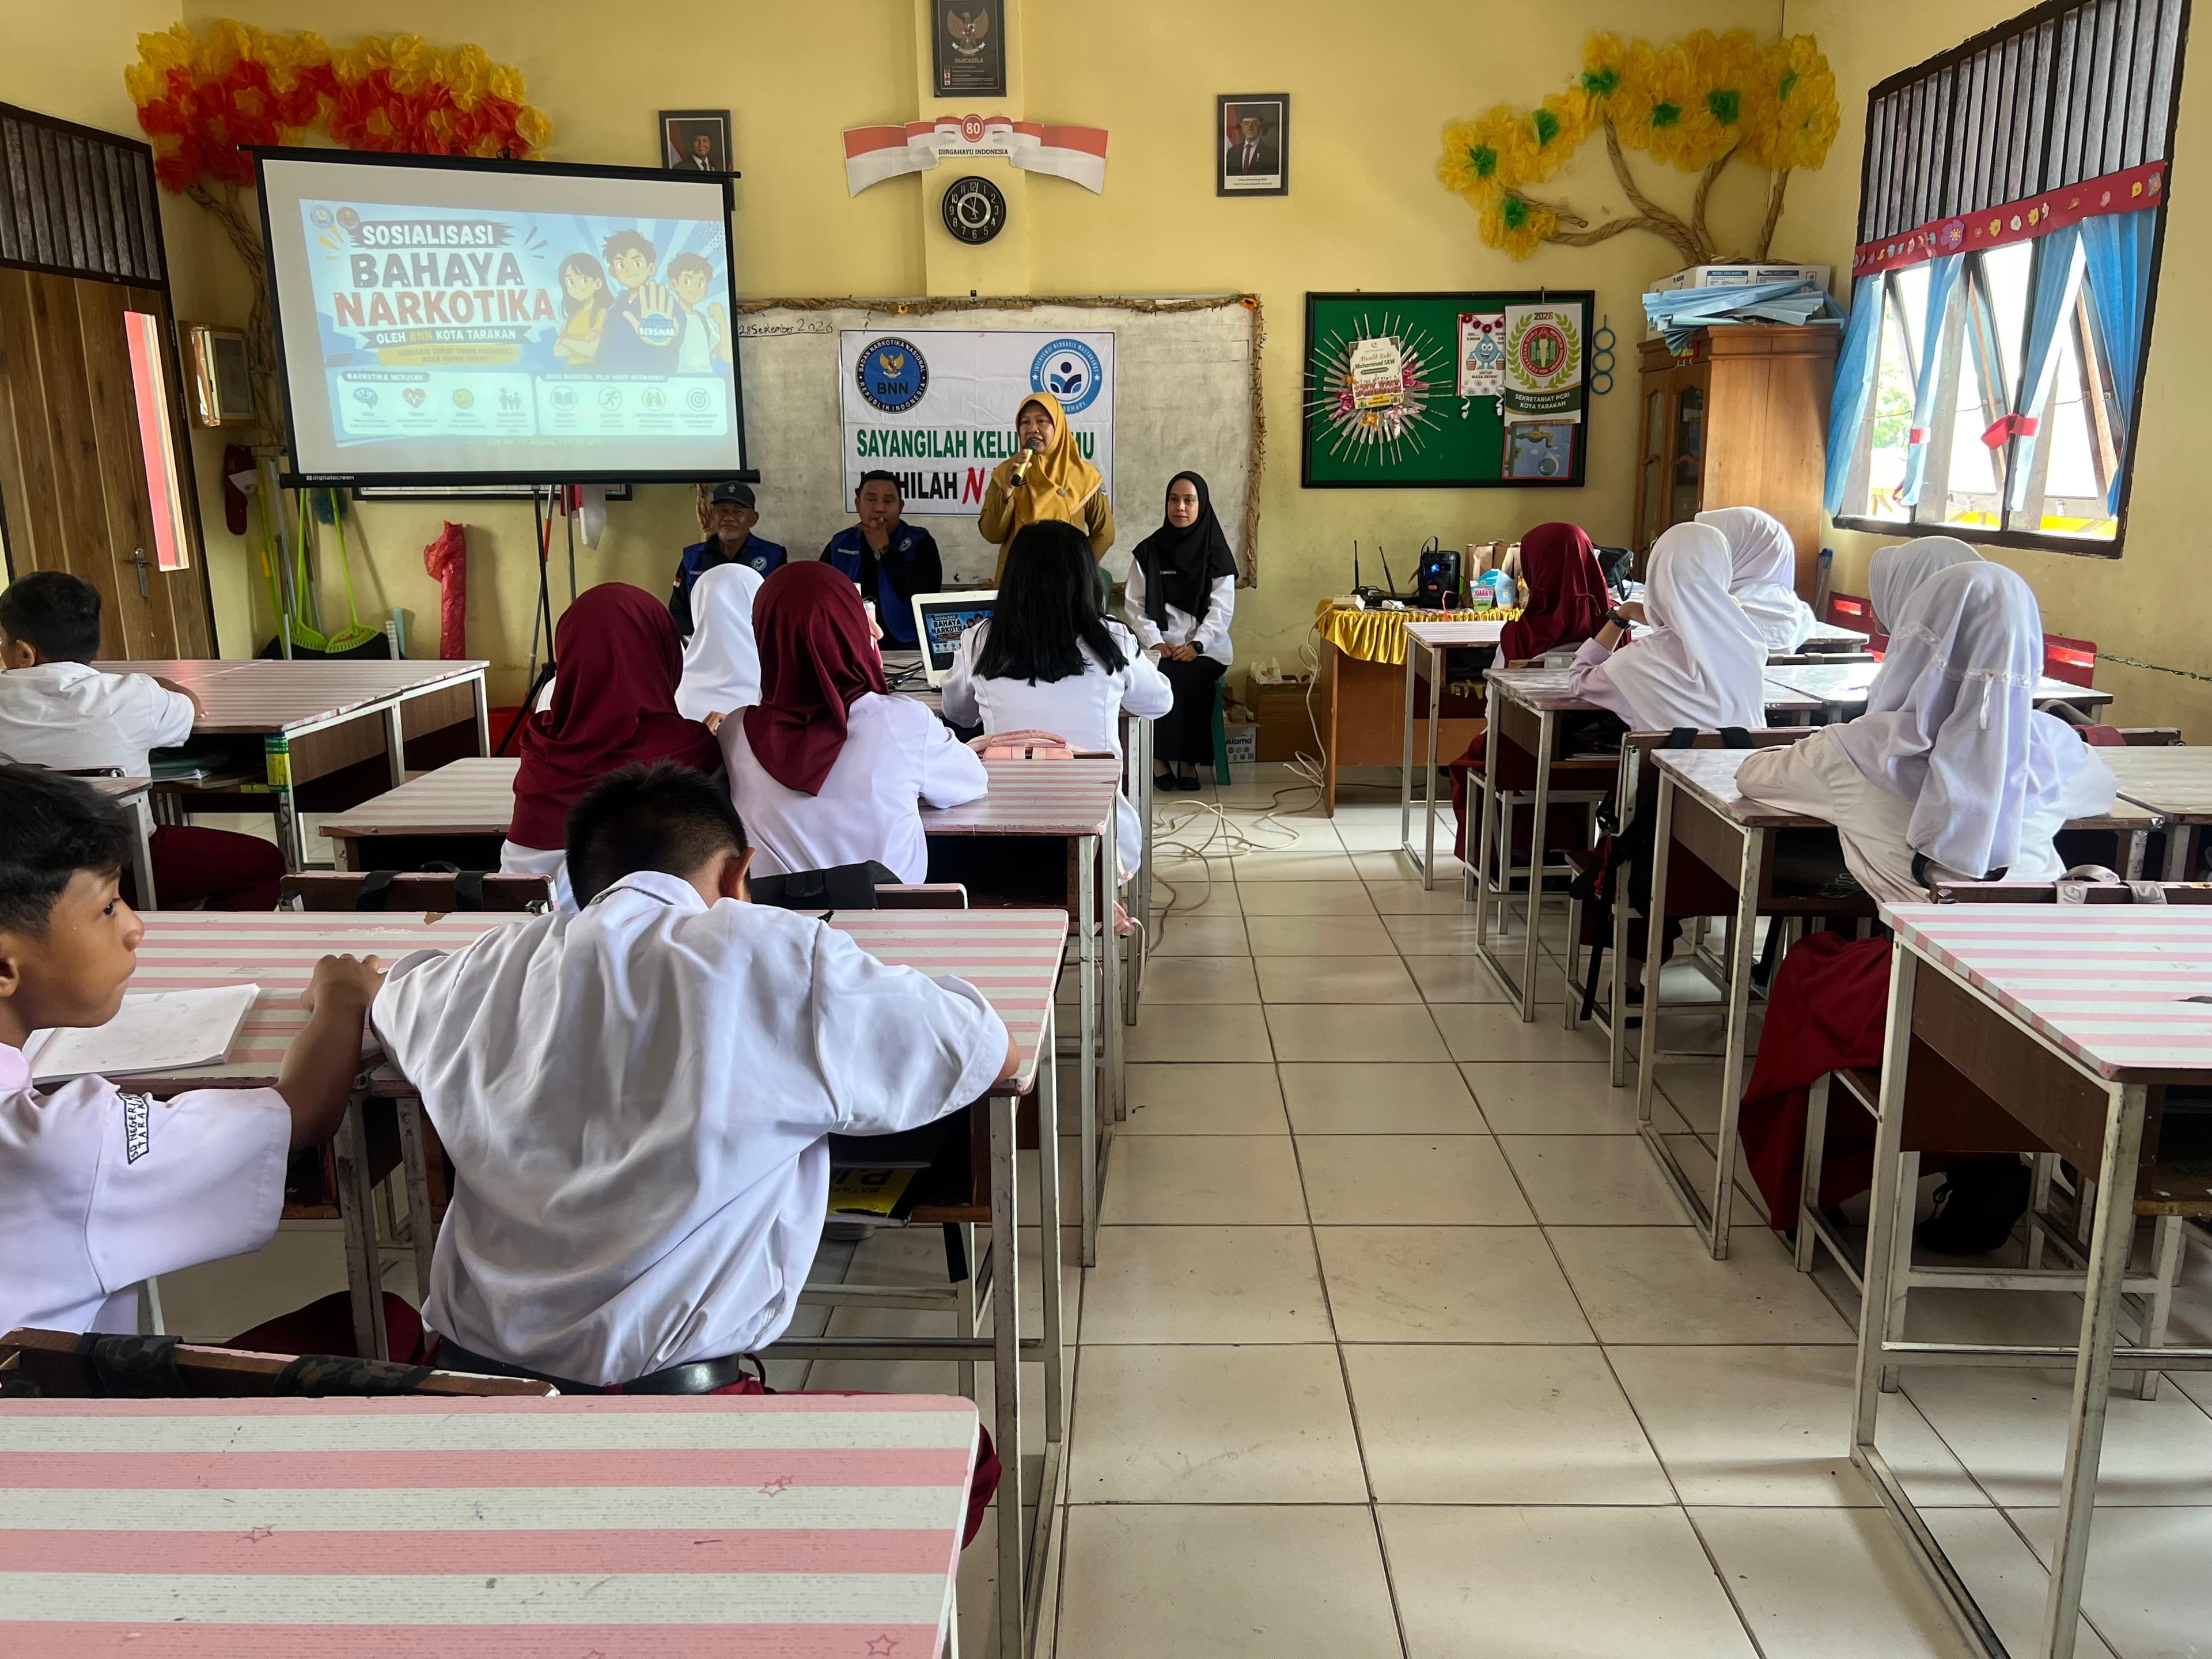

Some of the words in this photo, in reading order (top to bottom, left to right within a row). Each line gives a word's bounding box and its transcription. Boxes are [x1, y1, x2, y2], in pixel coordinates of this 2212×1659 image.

[967, 123, 980, 134] 80
[983, 185, 986, 194] 1
[952, 194, 958, 203] 10
[991, 194, 995, 203] 2
[949, 206, 954, 215] 9
[994, 206, 999, 215] 3
[953, 218, 957, 227] 8
[991, 217, 995, 226] 4
[362, 225, 494, 245] SOSIALISASI
[961, 226, 966, 235] 7
[972, 229, 977, 238] 6
[983, 226, 988, 235] 5
[350, 252, 525, 288] BAHAYA
[333, 289, 555, 327] NARKOTIKA
[1534, 312, 1554, 320] 2026
[751, 324, 794, 335] September
[376, 332, 406, 344] OLEH
[409, 331, 433, 342] BNN
[436, 330, 464, 342] KOTA
[466, 329, 516, 340] TARAKAN
[858, 351, 871, 372] BADAN
[870, 340, 904, 351] NARKOTIKA
[904, 344, 926, 373] NASIONAL
[877, 382, 908, 395] BNN
[859, 381, 890, 411] REPUBLIK
[892, 383, 926, 411] INDONESIA
[1515, 394, 1554, 402] SEKRETARIAT
[1555, 392, 1570, 400] PGRI
[1537, 400, 1566, 410] TARAKAN
[857, 429, 967, 458] SAYANGILAH
[933, 619, 961, 628] BAHAYA
[128, 1103, 138, 1141] NEGERI
[130, 1145, 138, 1158] SD
